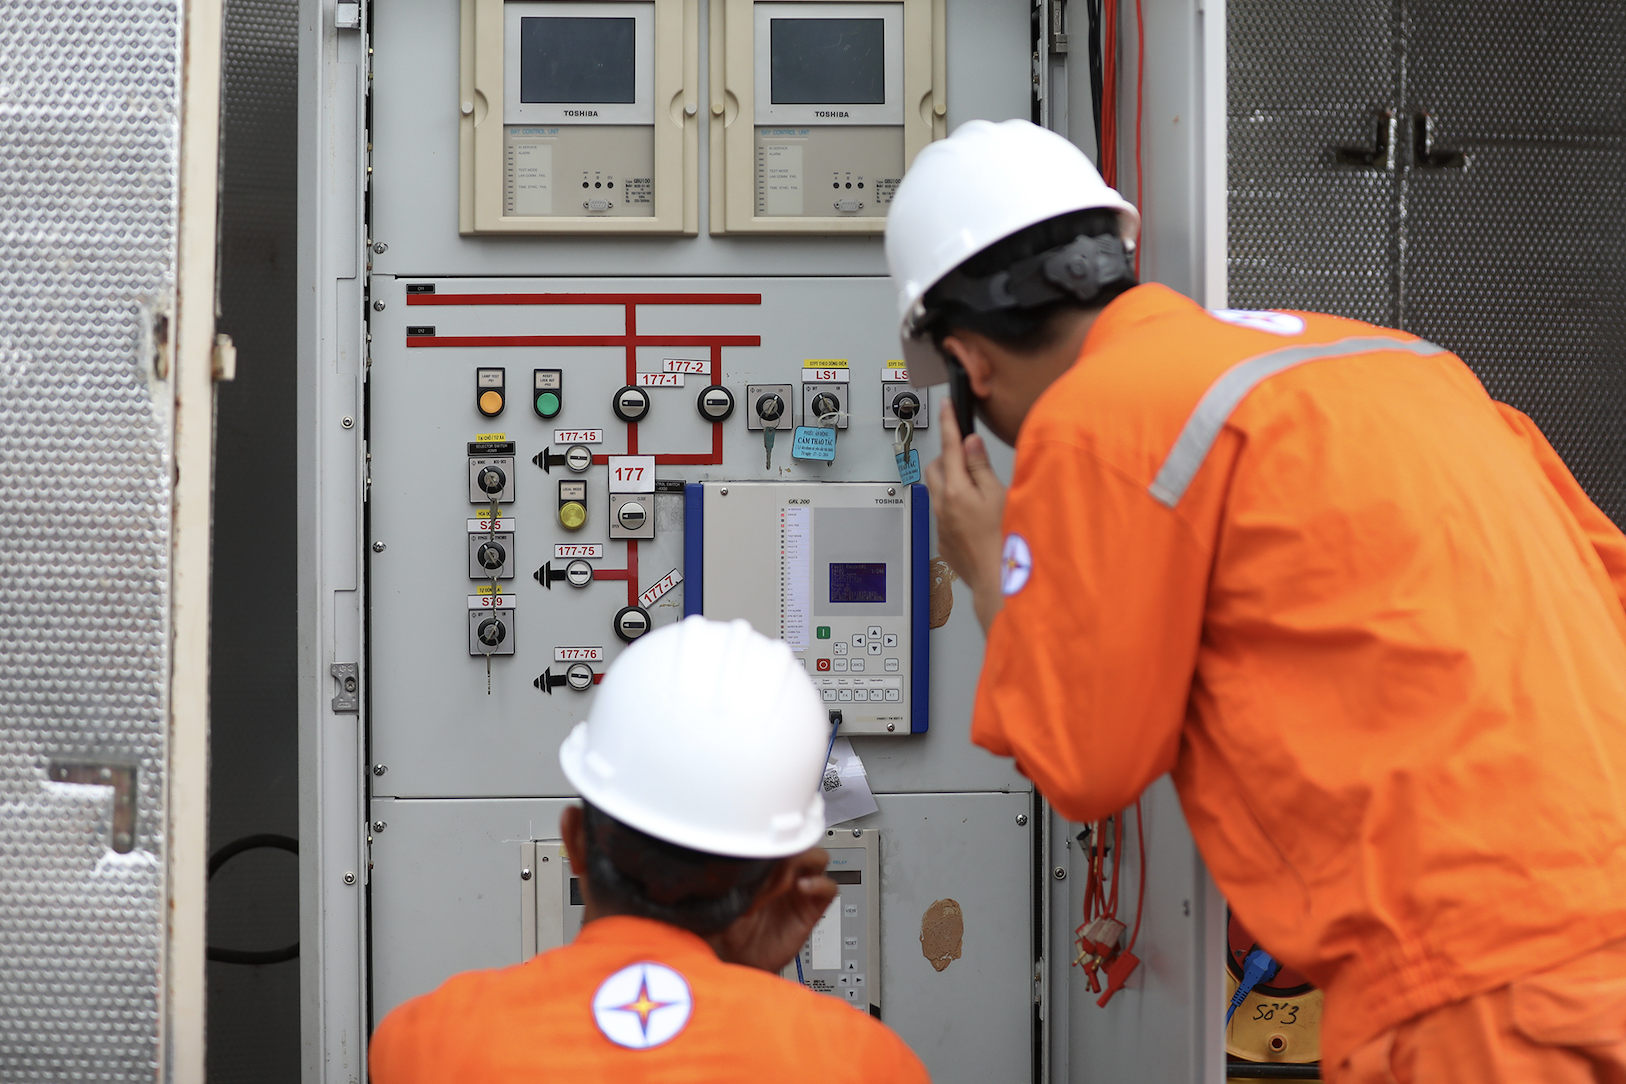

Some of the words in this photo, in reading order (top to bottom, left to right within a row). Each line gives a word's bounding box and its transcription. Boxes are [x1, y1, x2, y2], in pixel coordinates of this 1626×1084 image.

[668, 360, 704, 372] 177-2
[643, 374, 677, 385] 177-1
[816, 371, 836, 380] LS1
[895, 370, 909, 380] LS
[560, 432, 596, 441] 177-15
[615, 468, 644, 481] 177
[480, 521, 501, 529] S25
[558, 547, 595, 555] 177-75
[644, 576, 673, 602] 177-7
[482, 597, 503, 606] S79
[560, 650, 597, 659] 177-76
[1280, 1006, 1300, 1024] 3
